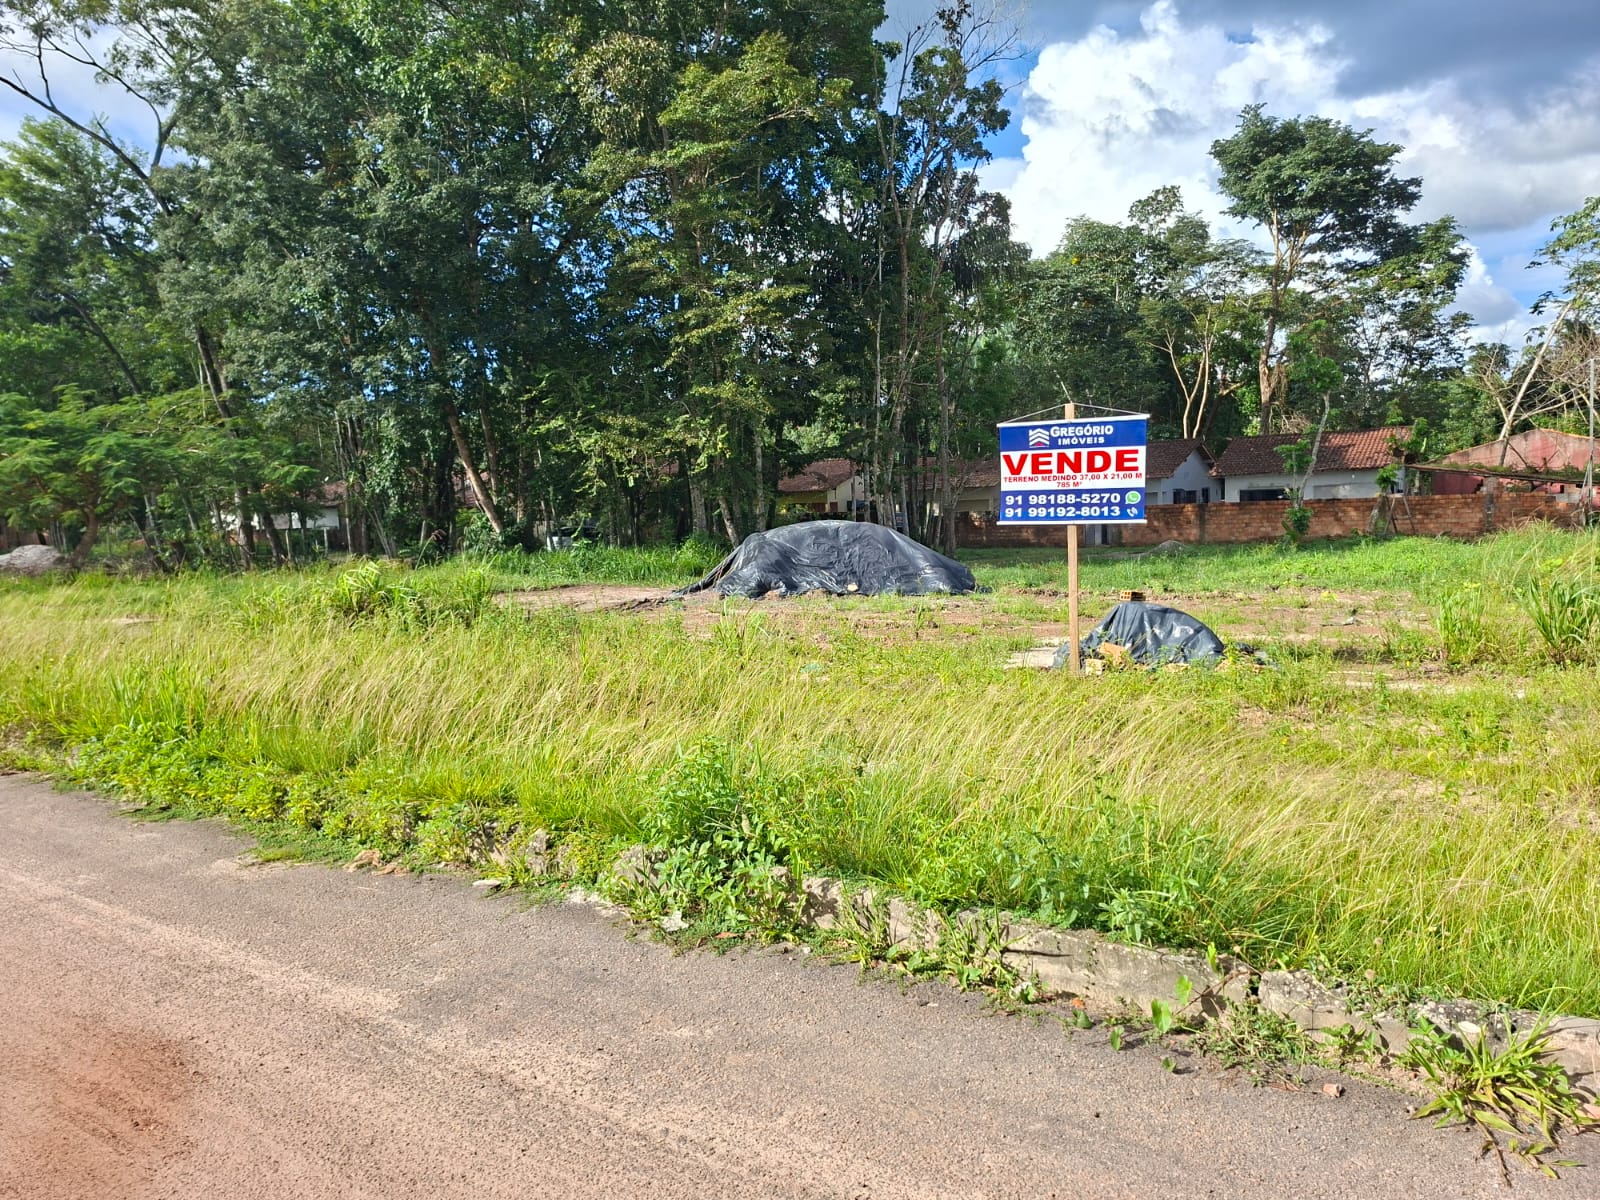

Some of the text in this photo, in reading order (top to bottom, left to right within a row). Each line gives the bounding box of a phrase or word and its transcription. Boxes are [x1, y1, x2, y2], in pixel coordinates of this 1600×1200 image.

[1050, 424, 1114, 437] GREGÓRIO
[1058, 435, 1105, 445] IMÓVEIS
[1002, 449, 1139, 475] VENDE
[1005, 493, 1121, 505] 91 98188-5270
[1005, 506, 1121, 517] 91 99192-8013
